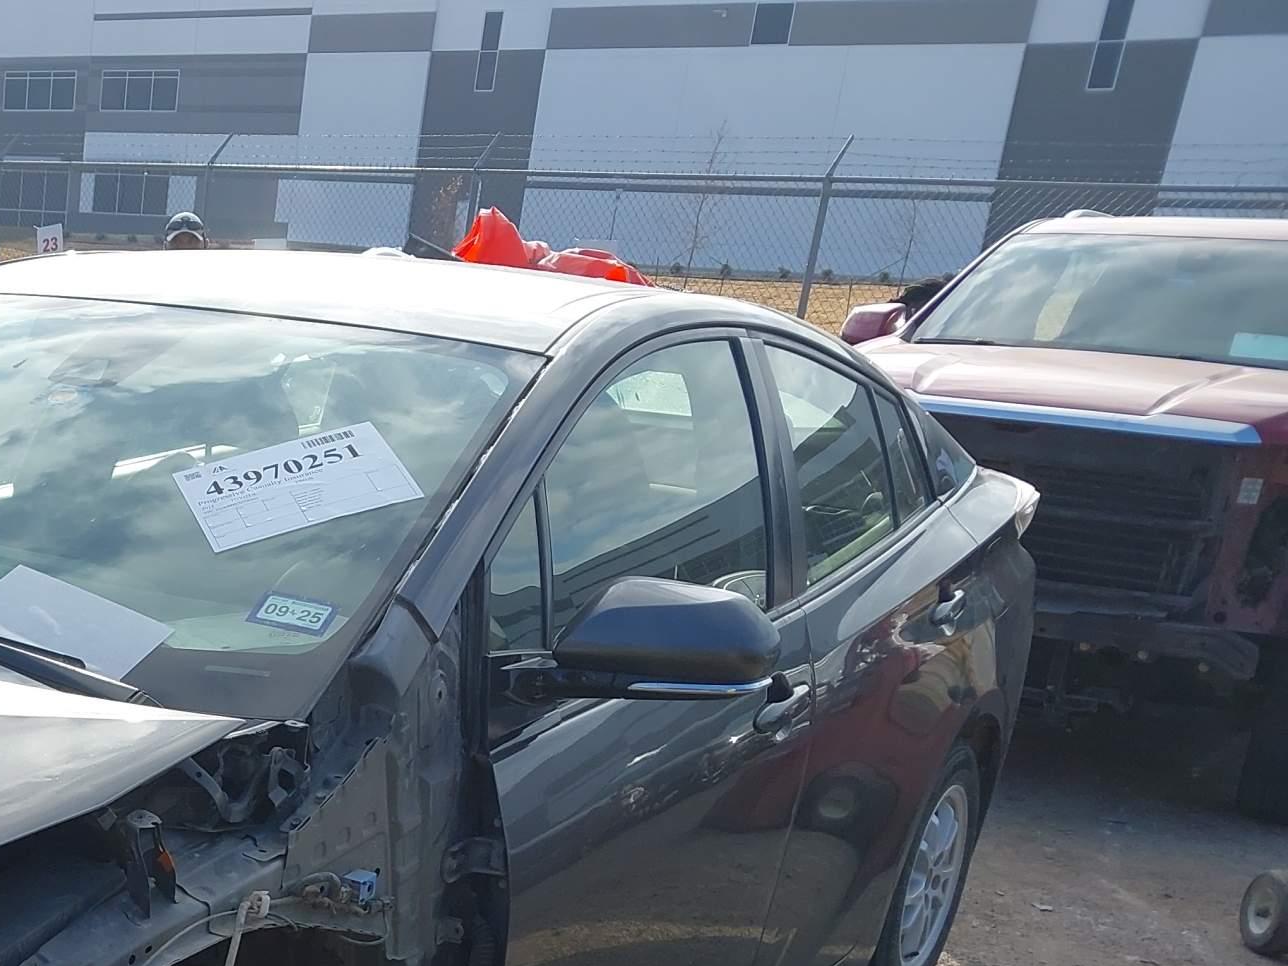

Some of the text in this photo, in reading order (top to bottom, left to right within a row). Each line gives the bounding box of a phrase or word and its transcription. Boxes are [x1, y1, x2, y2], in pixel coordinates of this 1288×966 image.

[42, 236, 59, 253] 23
[206, 444, 363, 495] 43970251
[264, 603, 290, 617] 09
[296, 609, 324, 624] 25
